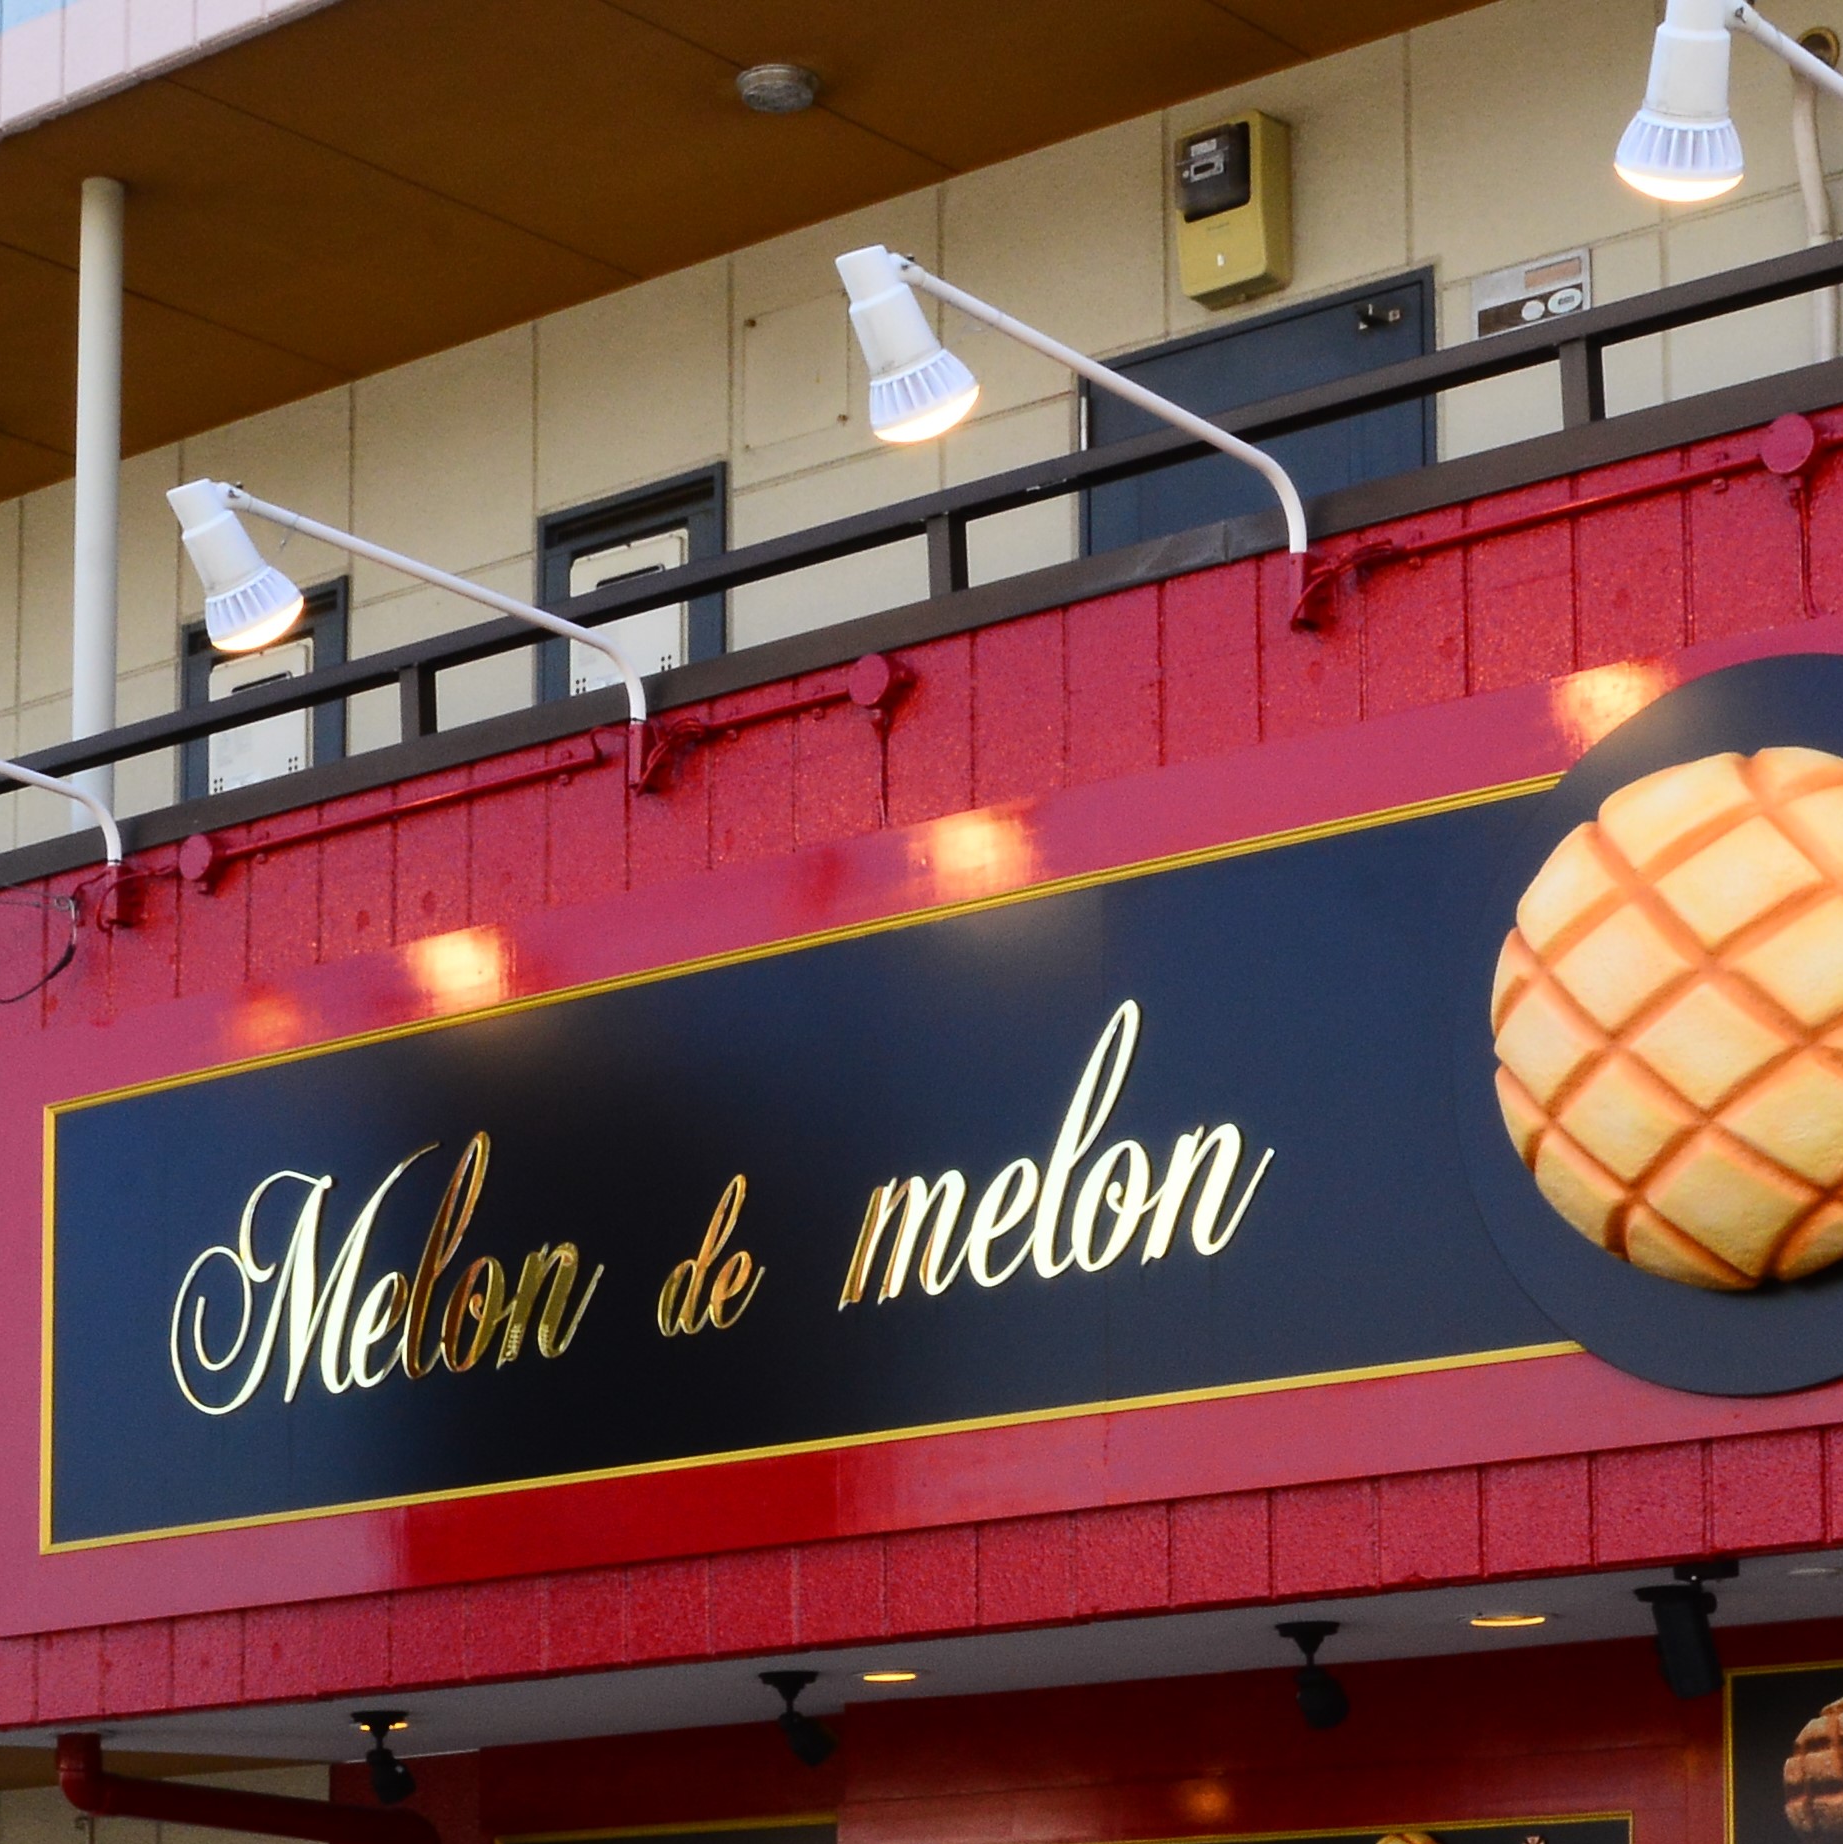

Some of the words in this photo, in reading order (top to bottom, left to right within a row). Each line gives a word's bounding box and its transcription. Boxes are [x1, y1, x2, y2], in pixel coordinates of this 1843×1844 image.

[170, 1131, 605, 1416] Melon
[657, 1172, 766, 1337] de
[837, 997, 1276, 1312] melon
